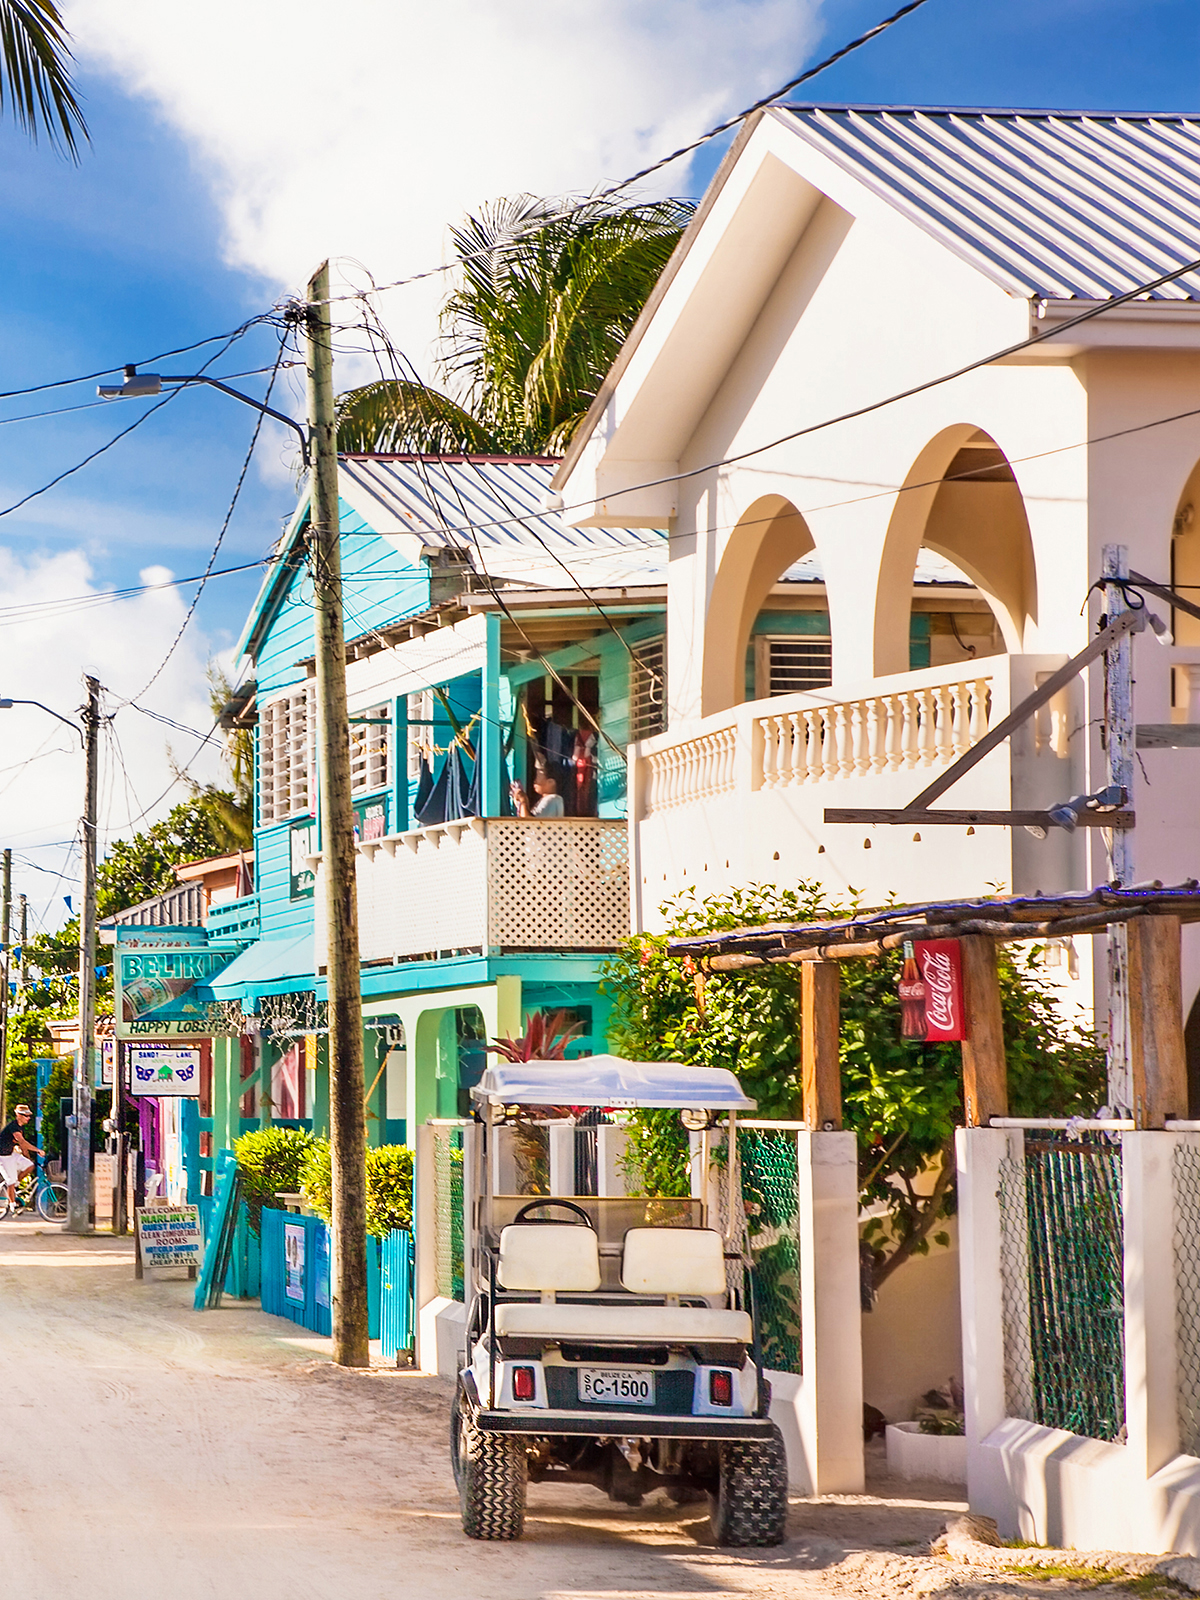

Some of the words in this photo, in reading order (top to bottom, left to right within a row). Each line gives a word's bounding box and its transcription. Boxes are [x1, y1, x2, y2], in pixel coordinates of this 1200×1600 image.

[921, 947, 955, 1032] Coca-Cola
[129, 1020, 171, 1034] HAPPY
[138, 1051, 159, 1059] SANDY
[175, 1051, 193, 1059] LANE
[139, 1206, 182, 1215] WELCOME
[184, 1205, 197, 1213] TO
[142, 1223, 168, 1232] GUEST
[169, 1222, 197, 1230] HOUSE
[156, 1237, 188, 1246] ROOMS
[150, 1258, 173, 1266] CHEAP
[600, 1371, 621, 1379] BELIZE
[593, 1378, 649, 1398] C-1500
